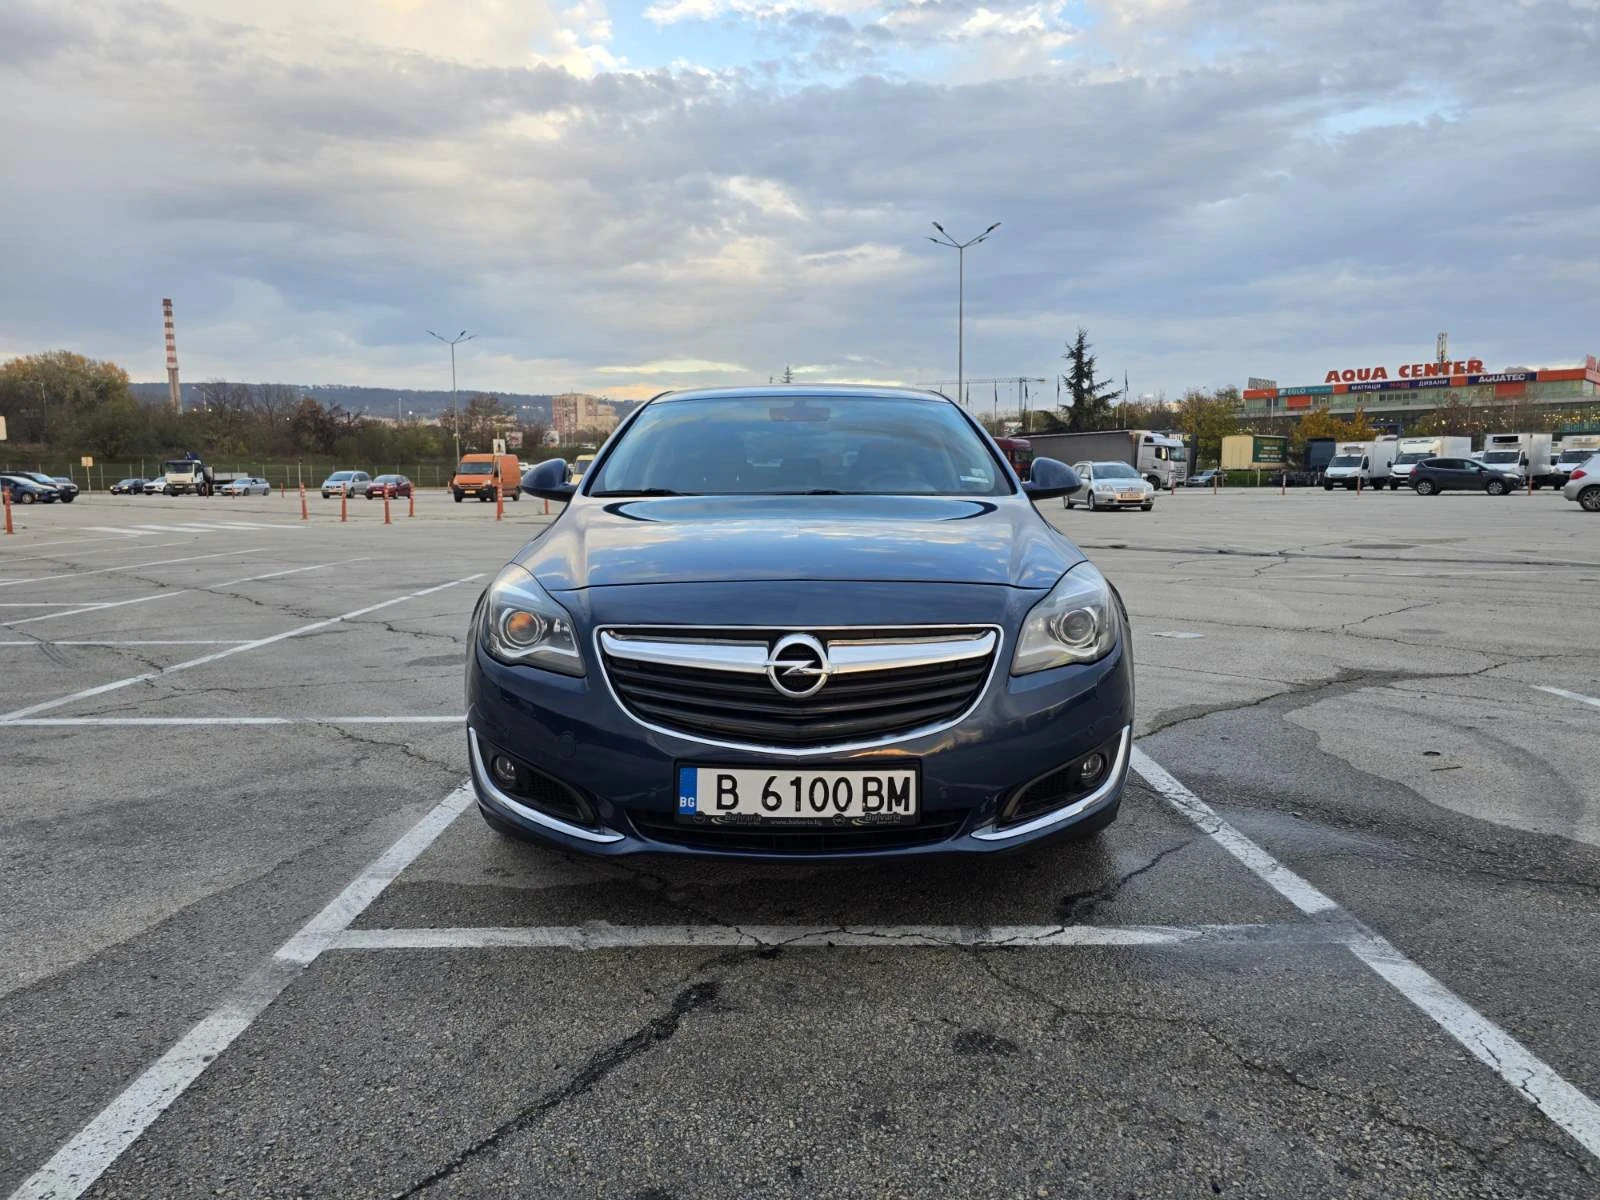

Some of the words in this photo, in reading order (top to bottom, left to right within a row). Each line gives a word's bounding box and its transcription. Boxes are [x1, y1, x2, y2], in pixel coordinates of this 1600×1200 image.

[1325, 366, 1388, 383] AQUA
[1398, 359, 1486, 378] CENTER
[1478, 373, 1525, 383] AQUATEC
[679, 796, 695, 808] BG
[716, 774, 739, 811] B
[761, 775, 853, 812] 6100
[862, 776, 911, 813] BM
